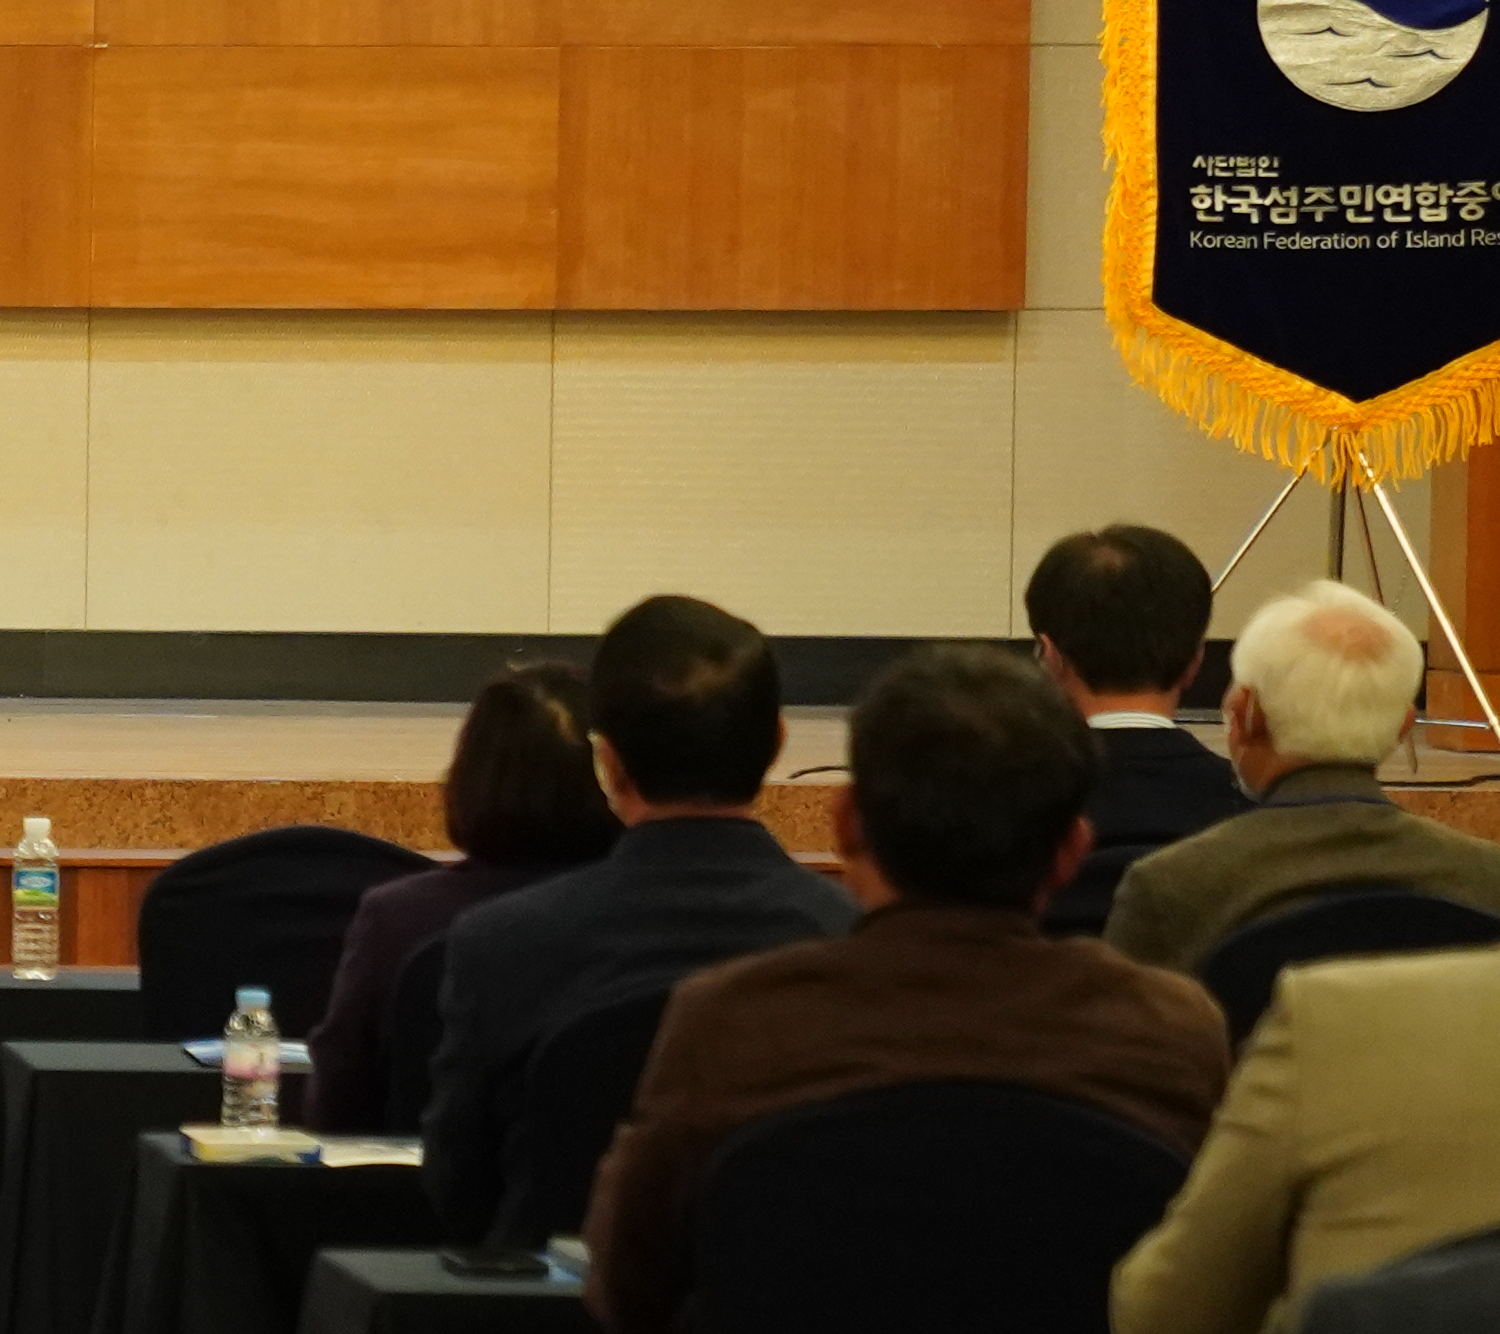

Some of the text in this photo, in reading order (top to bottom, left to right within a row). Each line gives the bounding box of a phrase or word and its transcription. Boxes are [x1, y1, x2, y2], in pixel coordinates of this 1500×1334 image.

[1193, 155, 1278, 177] 사단법인
[1191, 232, 1257, 248] Korean
[1264, 233, 1370, 249] Federation
[1377, 231, 1398, 248] of
[1406, 230, 1464, 248] Island
